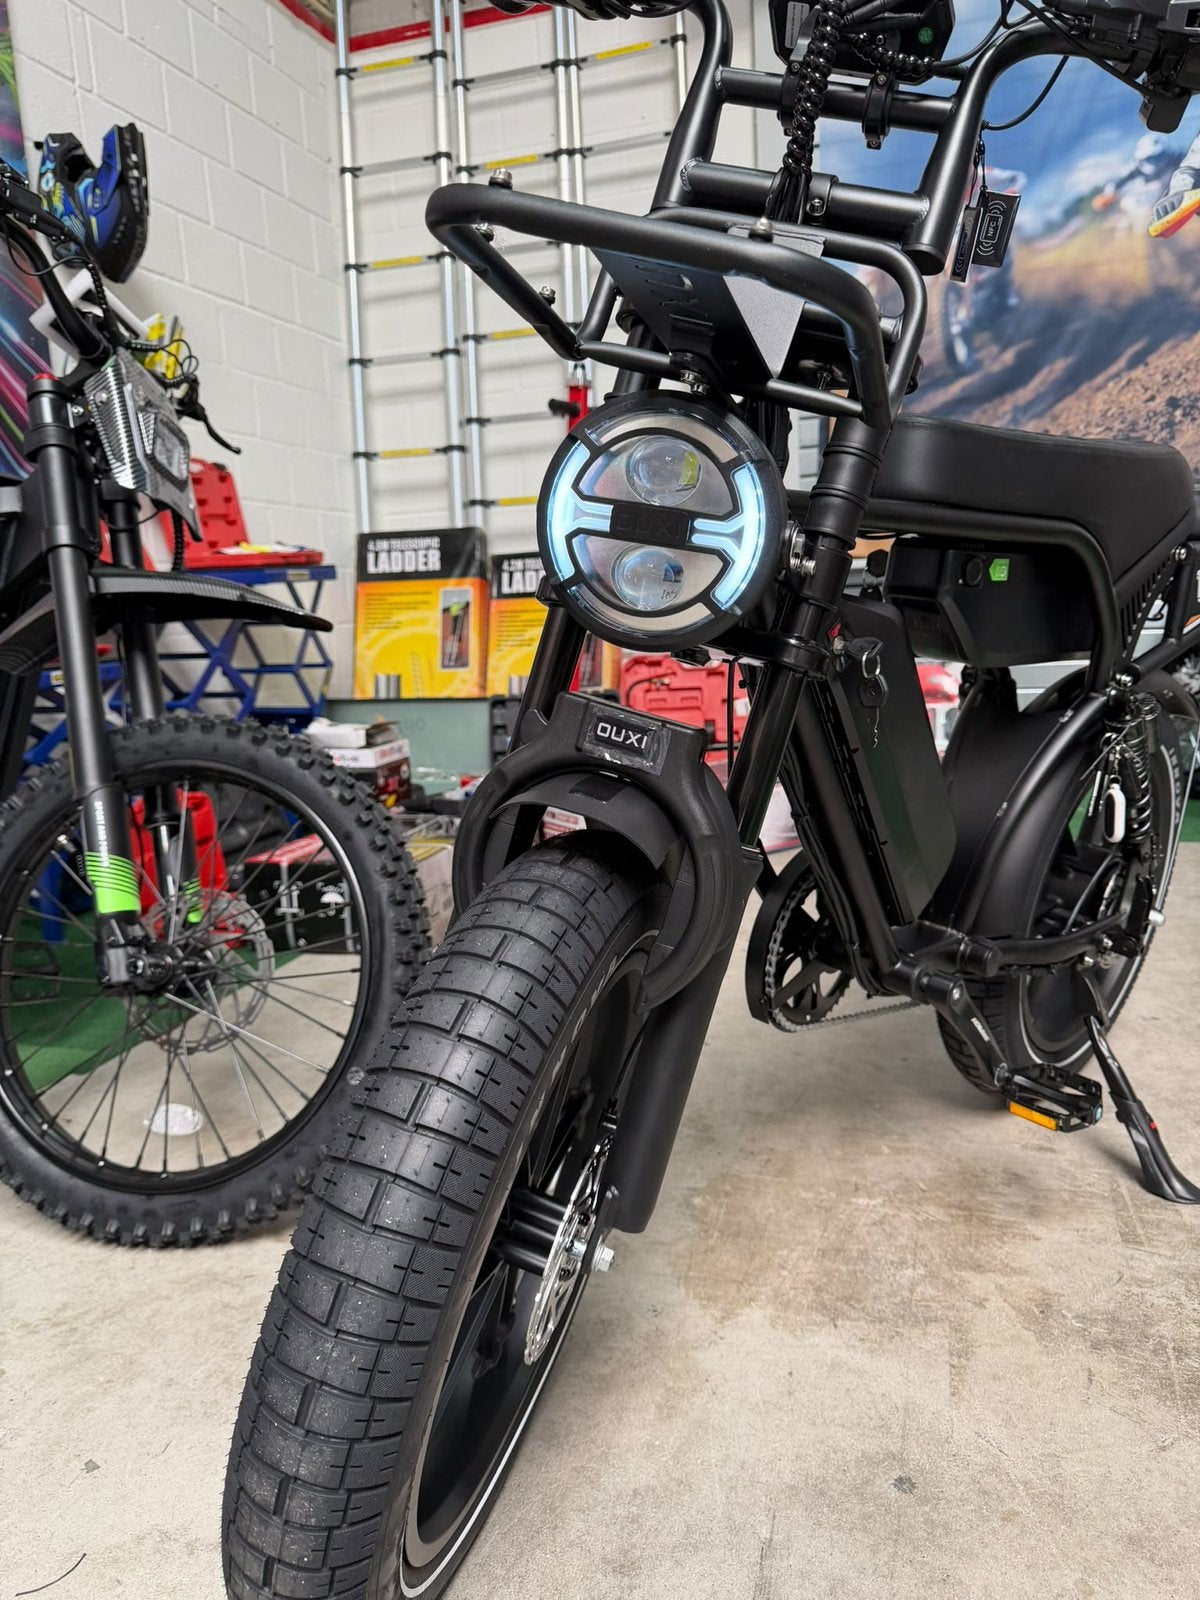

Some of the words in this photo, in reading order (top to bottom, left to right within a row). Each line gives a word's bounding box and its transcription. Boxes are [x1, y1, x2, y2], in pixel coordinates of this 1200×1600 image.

[987, 221, 996, 237] NFC
[615, 512, 681, 540] OUXI
[367, 549, 441, 574] LADDER
[597, 722, 647, 749] OUXI
